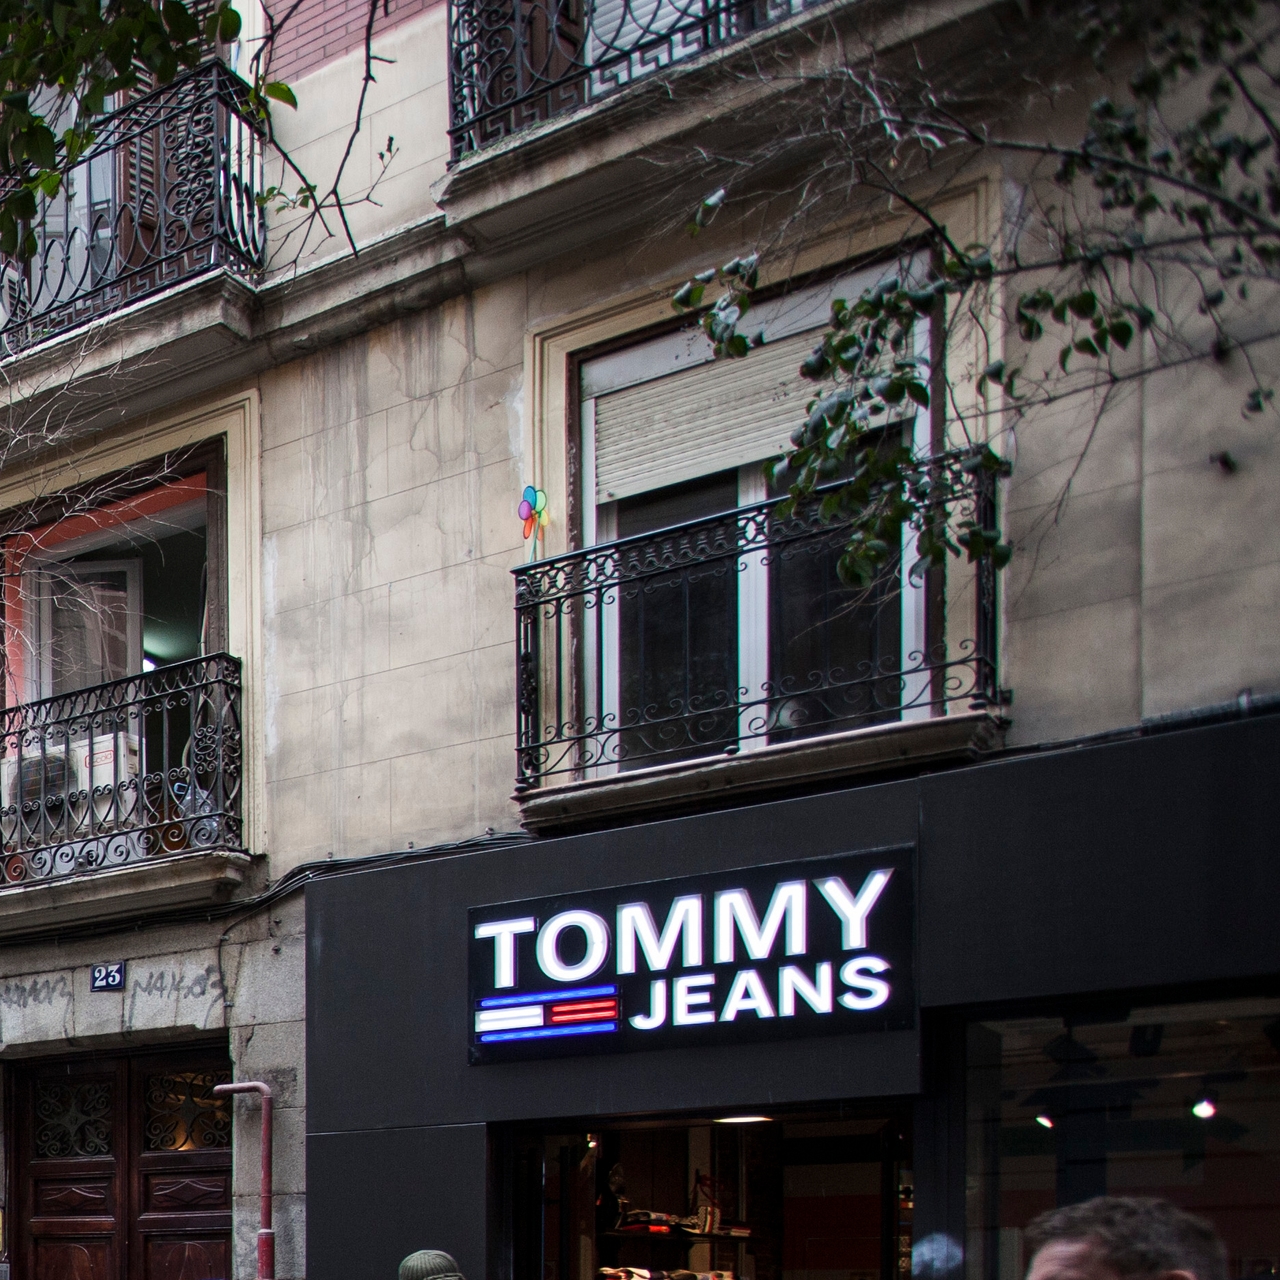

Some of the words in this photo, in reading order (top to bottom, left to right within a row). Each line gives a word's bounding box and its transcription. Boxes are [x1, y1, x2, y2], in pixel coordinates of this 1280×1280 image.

[473, 867, 896, 990] TOMMY
[93, 963, 121, 988] 23
[628, 955, 893, 1031] JEANS
